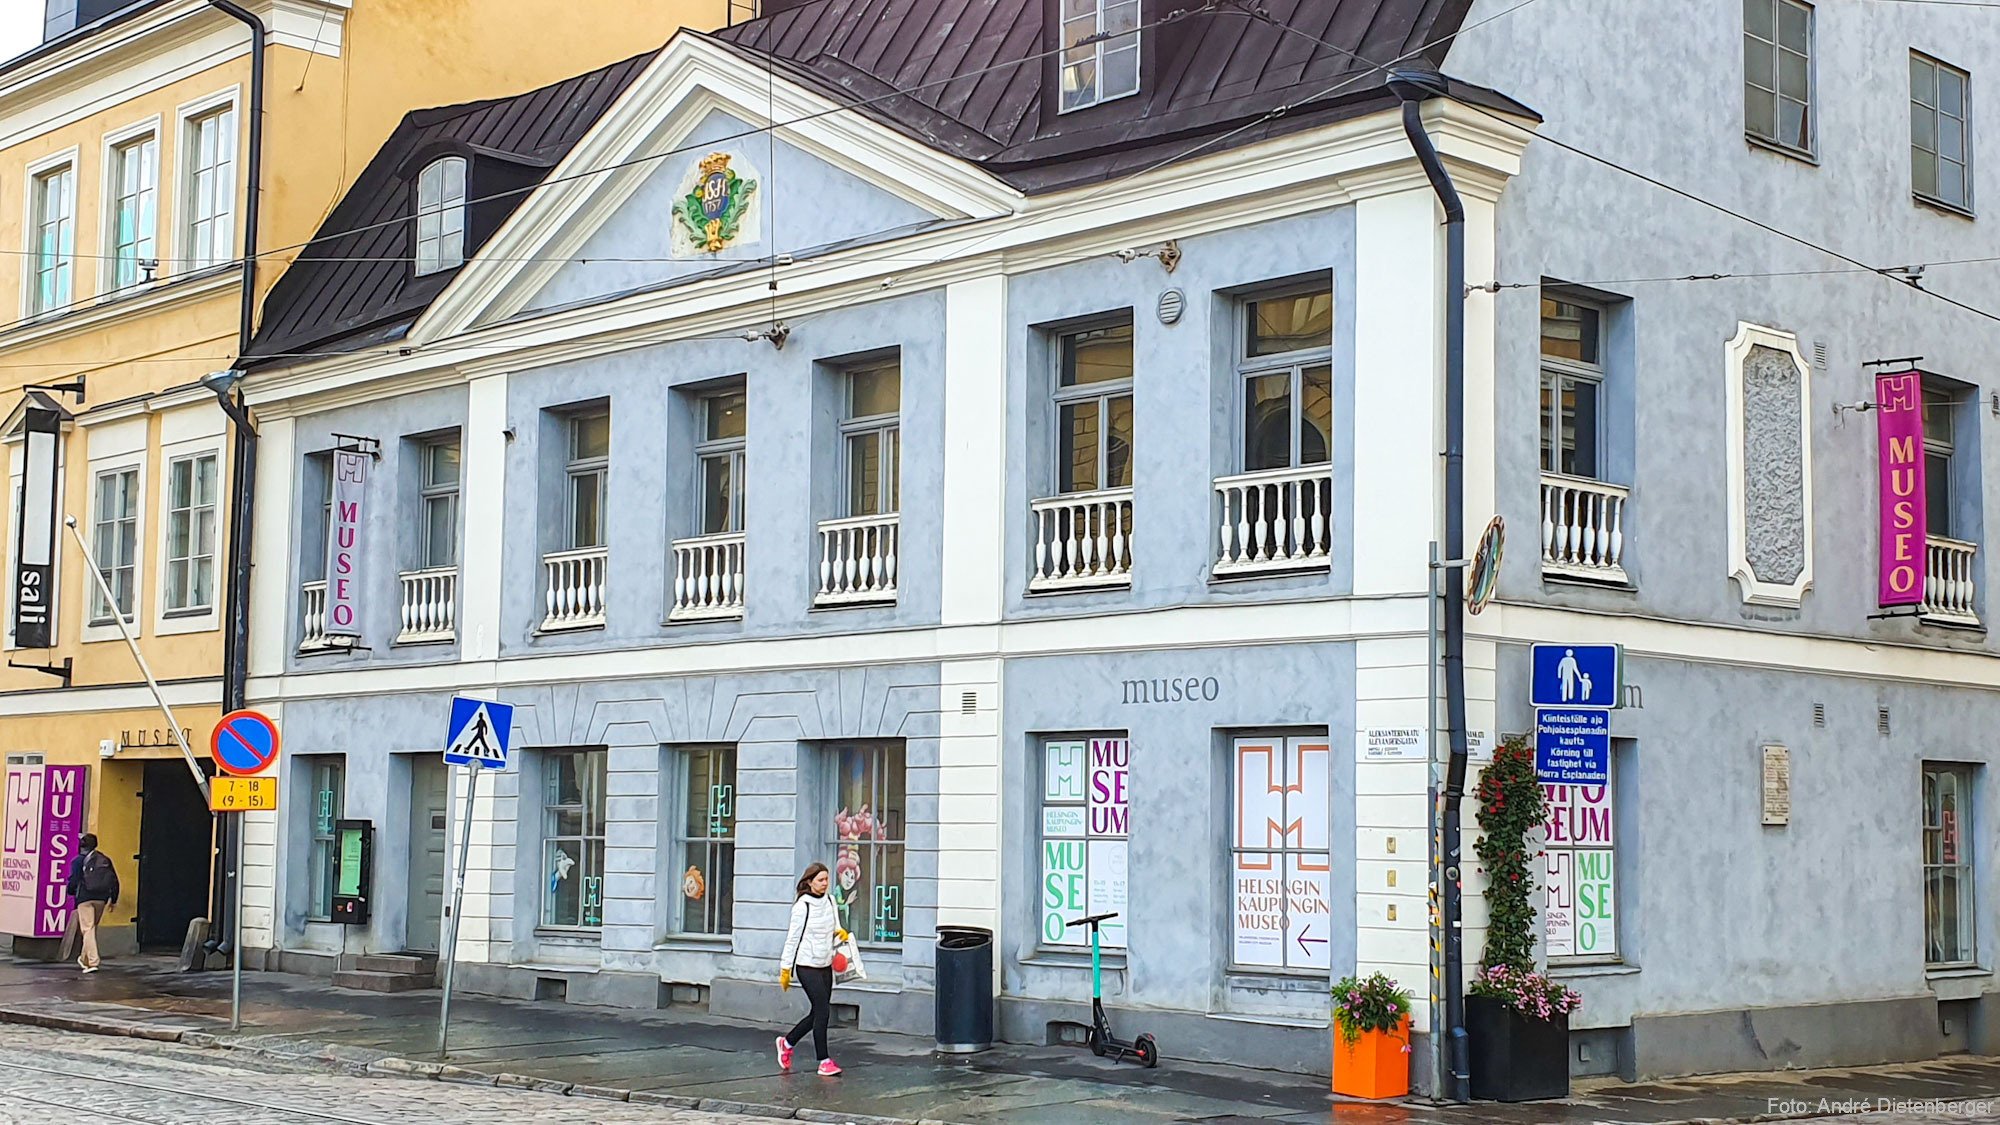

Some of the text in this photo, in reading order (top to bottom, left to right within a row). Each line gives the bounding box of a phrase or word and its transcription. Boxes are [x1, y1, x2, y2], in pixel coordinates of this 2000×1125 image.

[1888, 435, 1915, 593] MUSEO
[333, 500, 358, 626] MUSEO
[20, 570, 47, 624] sali
[1121, 675, 1220, 705] museo
[1542, 714, 1604, 725] Kiinteistölle ajo
[121, 728, 192, 748] MUSEO
[1559, 736, 1585, 746] kautta
[1550, 748, 1594, 758] Körning till
[1547, 759, 1597, 769] fastighet via
[1537, 769, 1606, 780] Norra Esplanaden
[229, 780, 235, 792] 7
[248, 780, 259, 792] 18
[222, 795, 235, 807] (9
[248, 795, 264, 807] 15)
[3, 857, 32, 869] HELSINGIN
[2, 880, 21, 892] MUSEO
[1238, 878, 1321, 896] HELSINGIN
[1238, 914, 1291, 931] MUSEO
